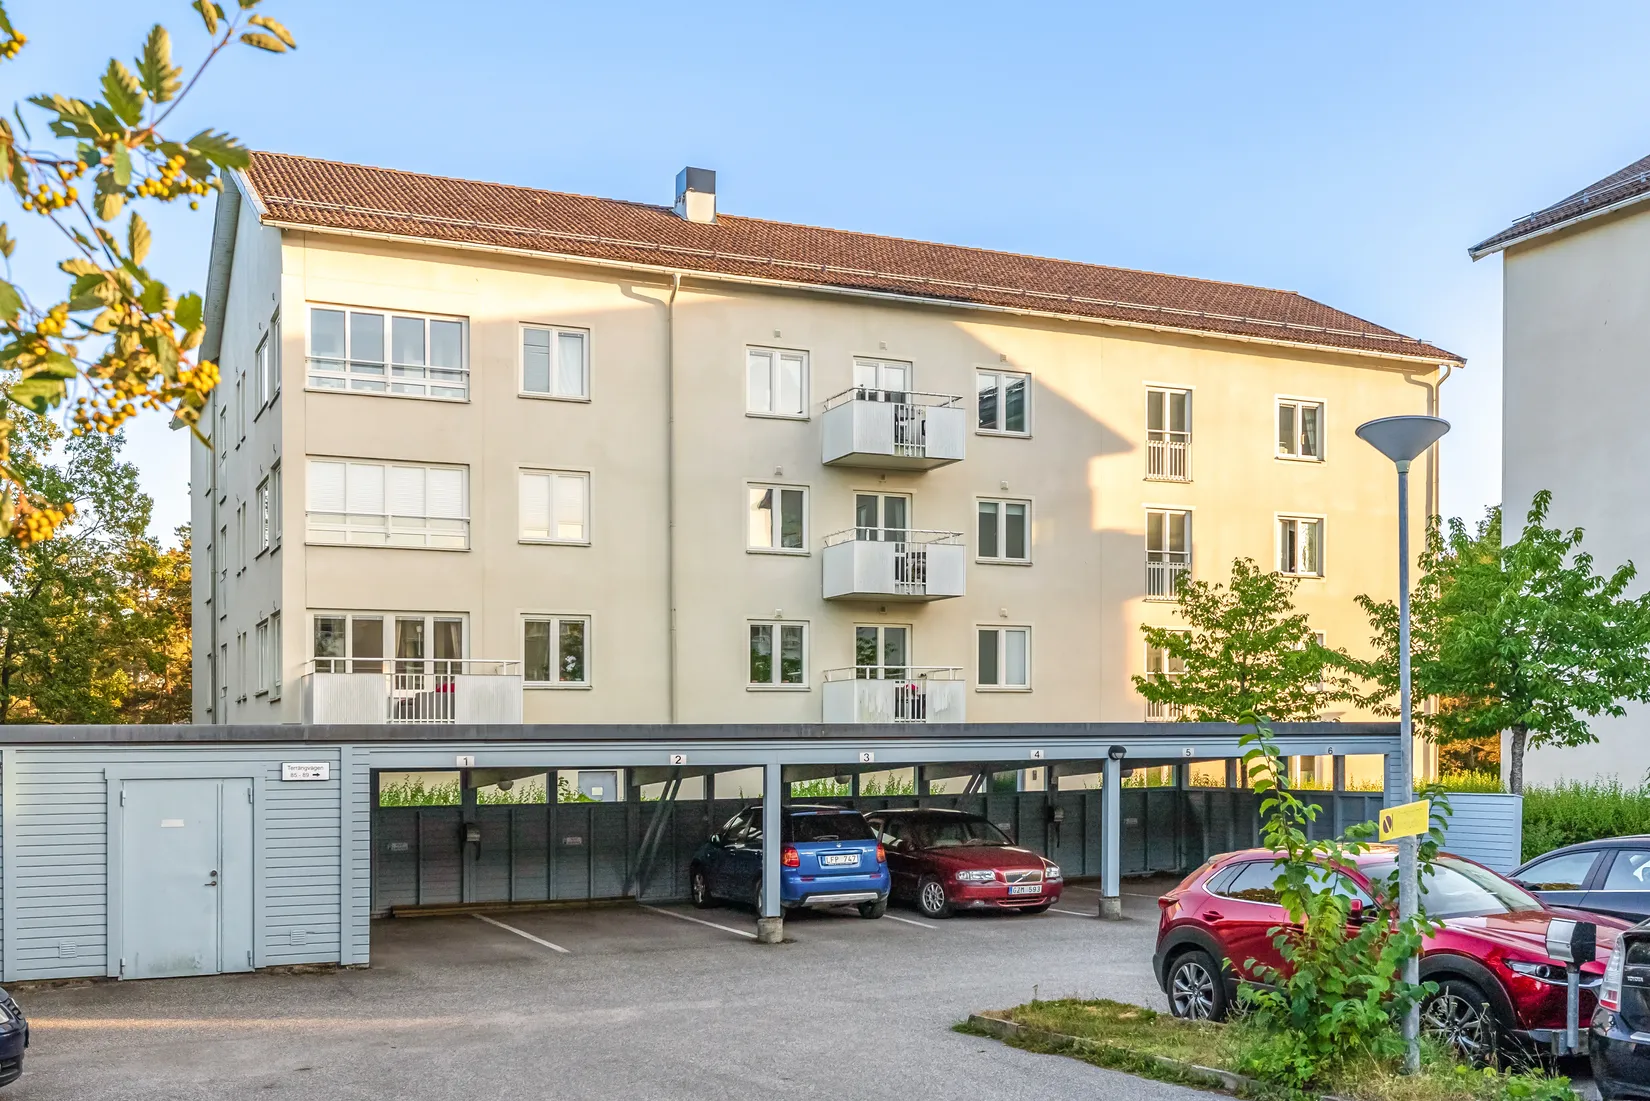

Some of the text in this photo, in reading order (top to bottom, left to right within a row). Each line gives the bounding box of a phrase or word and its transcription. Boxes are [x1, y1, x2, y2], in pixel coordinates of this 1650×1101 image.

[1034, 750, 1040, 759] 4
[1185, 748, 1191, 757] 5
[1327, 746, 1333, 755] 6
[463, 757, 468, 766] 1
[675, 755, 682, 764] 2
[863, 752, 870, 762] 3
[826, 856, 839, 864] LFP
